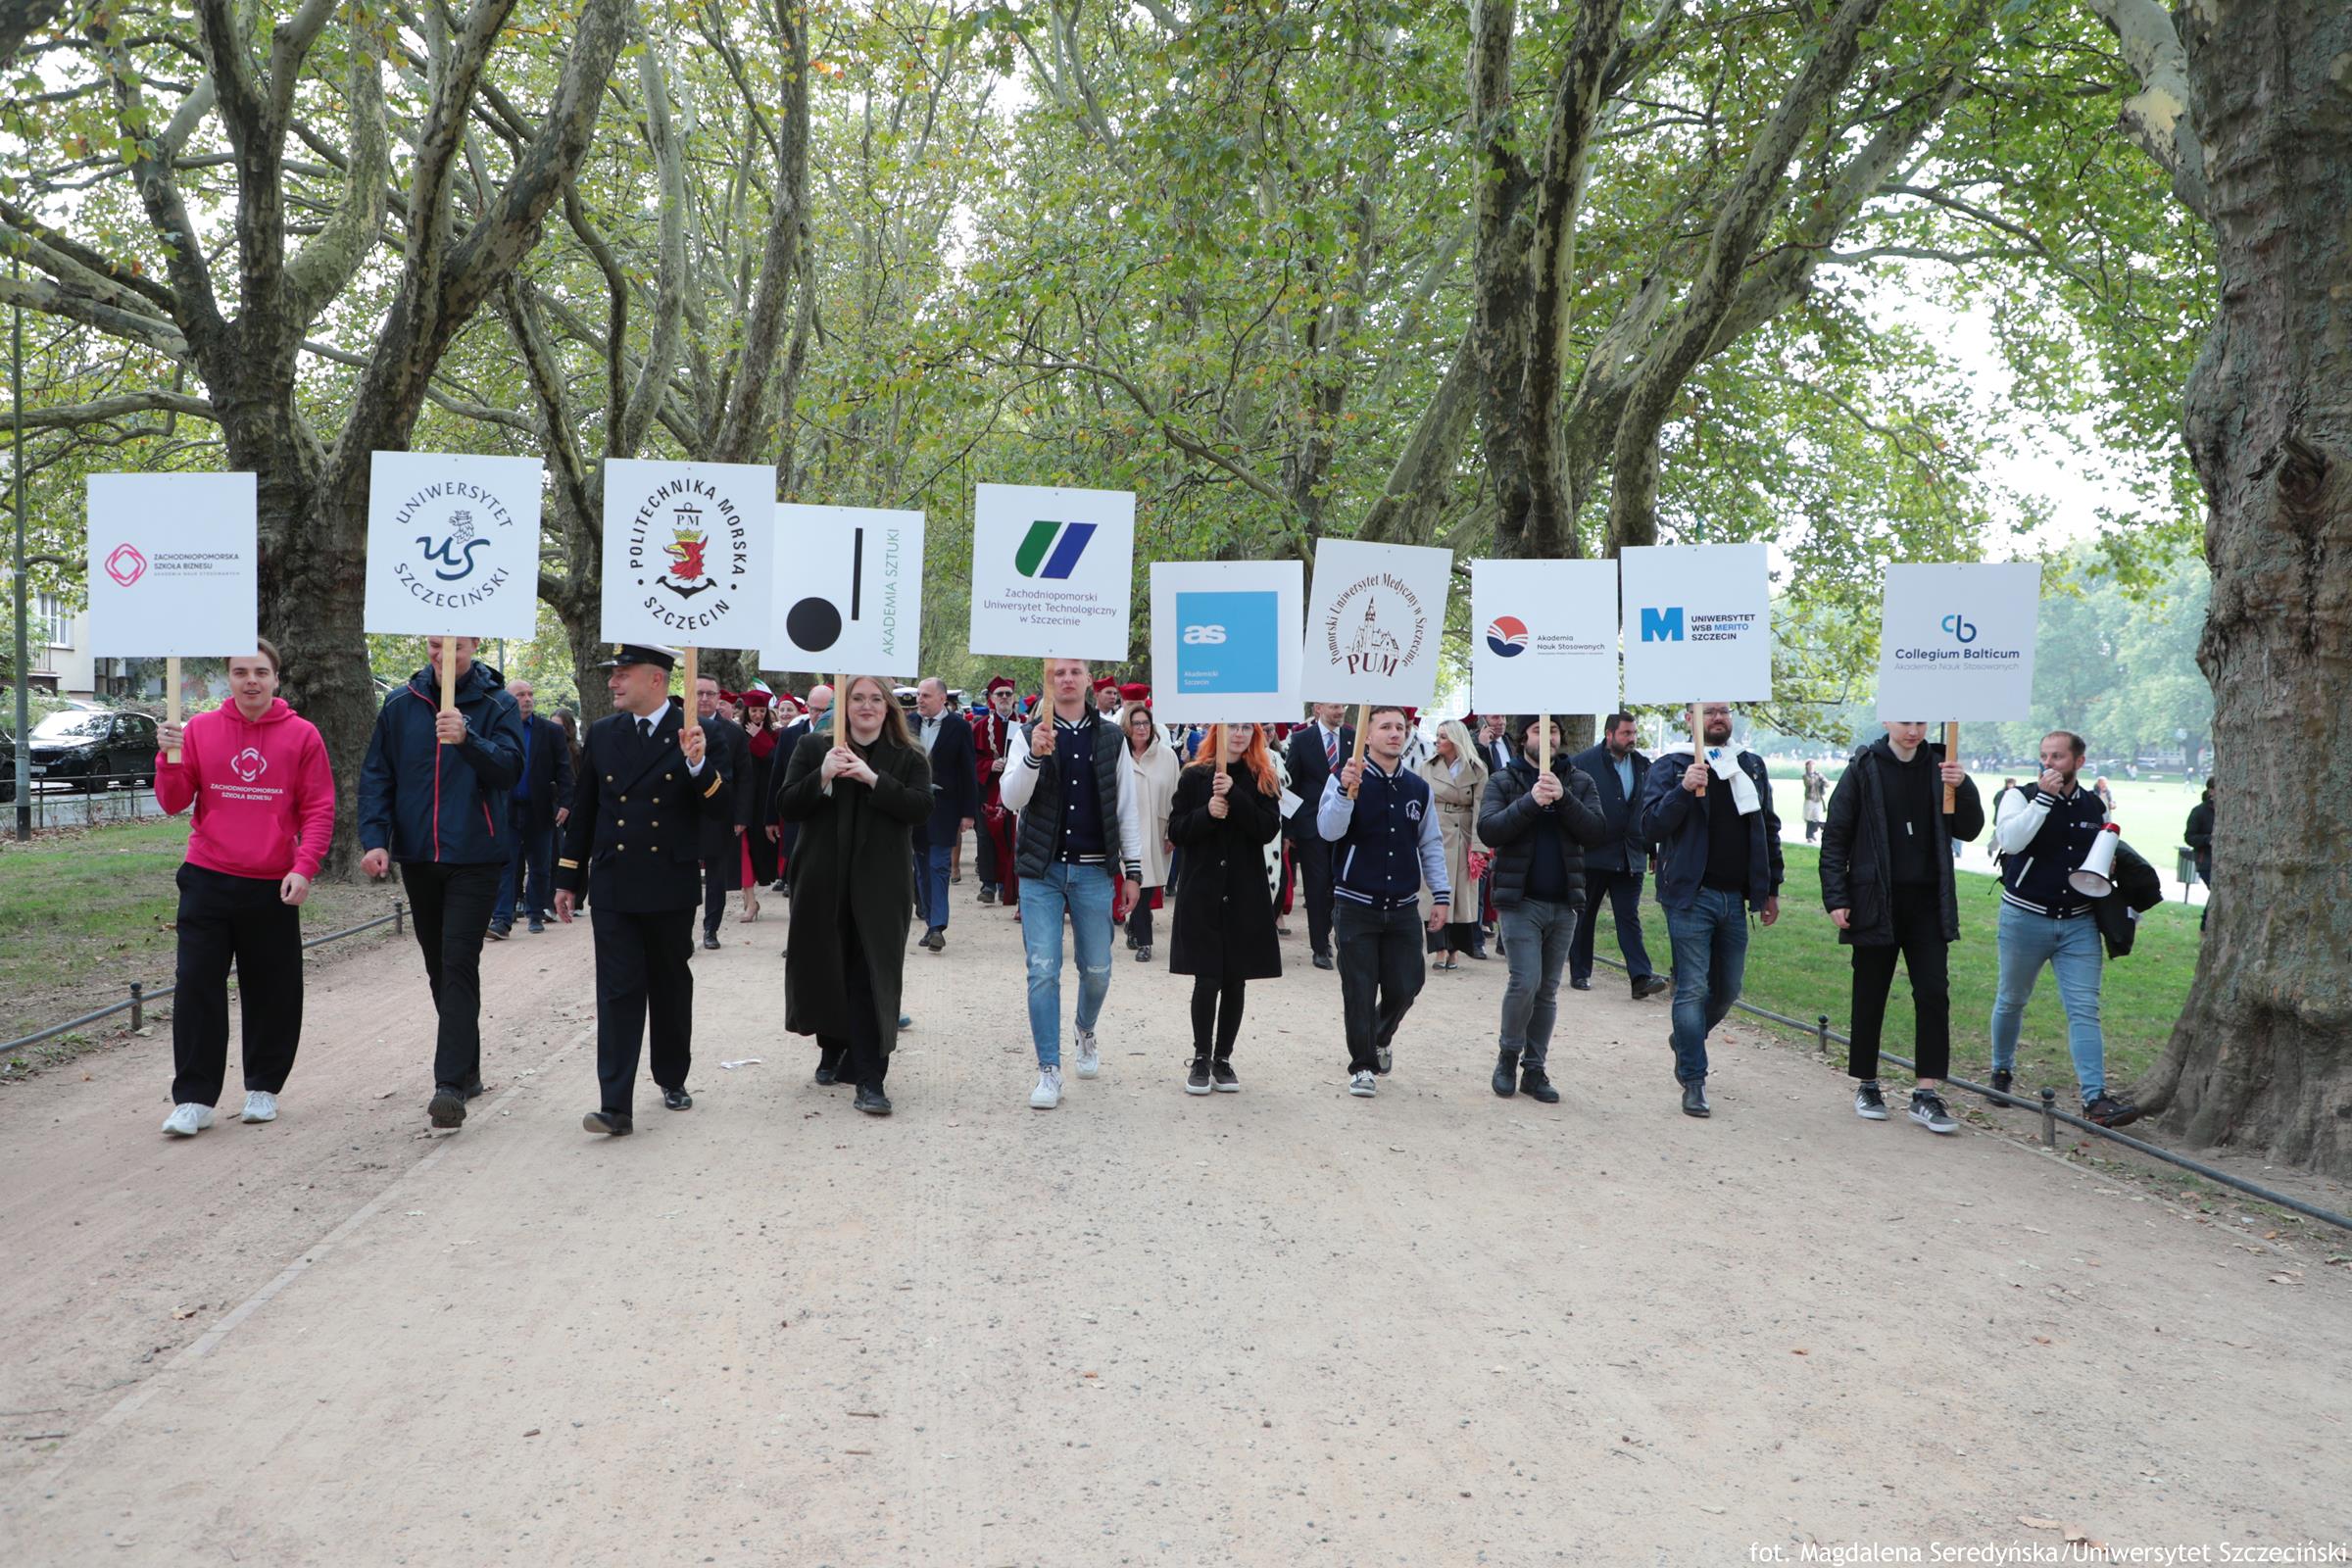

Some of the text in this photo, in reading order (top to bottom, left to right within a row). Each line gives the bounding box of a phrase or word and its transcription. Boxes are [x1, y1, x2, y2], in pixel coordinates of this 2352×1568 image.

[396, 481, 513, 528] UNIWERSYTET
[629, 478, 747, 574] POLITECHNIKA MORSKA
[394, 563, 509, 609] SZCZECIŃSKI
[883, 528, 901, 657] AKADEMIA SZTUKI
[1004, 588, 1098, 602] Zachodniopomorski
[1329, 574, 1379, 613] Uniwersytet
[1382, 572, 1419, 608] Medyczny
[644, 596, 730, 630] SZCZECIN
[983, 600, 1117, 616] Uniwersytet Technologiczny
[1031, 614, 1081, 626] Szczecinie
[1691, 614, 1755, 623] UNIWERSYTET
[1183, 624, 1227, 644] as
[1641, 607, 1684, 642] M
[1325, 615, 1343, 665] Pomorski
[1401, 617, 1427, 666] Szczecinie
[1558, 643, 1604, 652] Stosowanych
[1347, 652, 1399, 677] PUM
[1895, 649, 2020, 662] Collegium Balticum
[1963, 662, 2020, 672] Stosowanych
[210, 783, 283, 794] ZACHODNIOPOMORSKA
